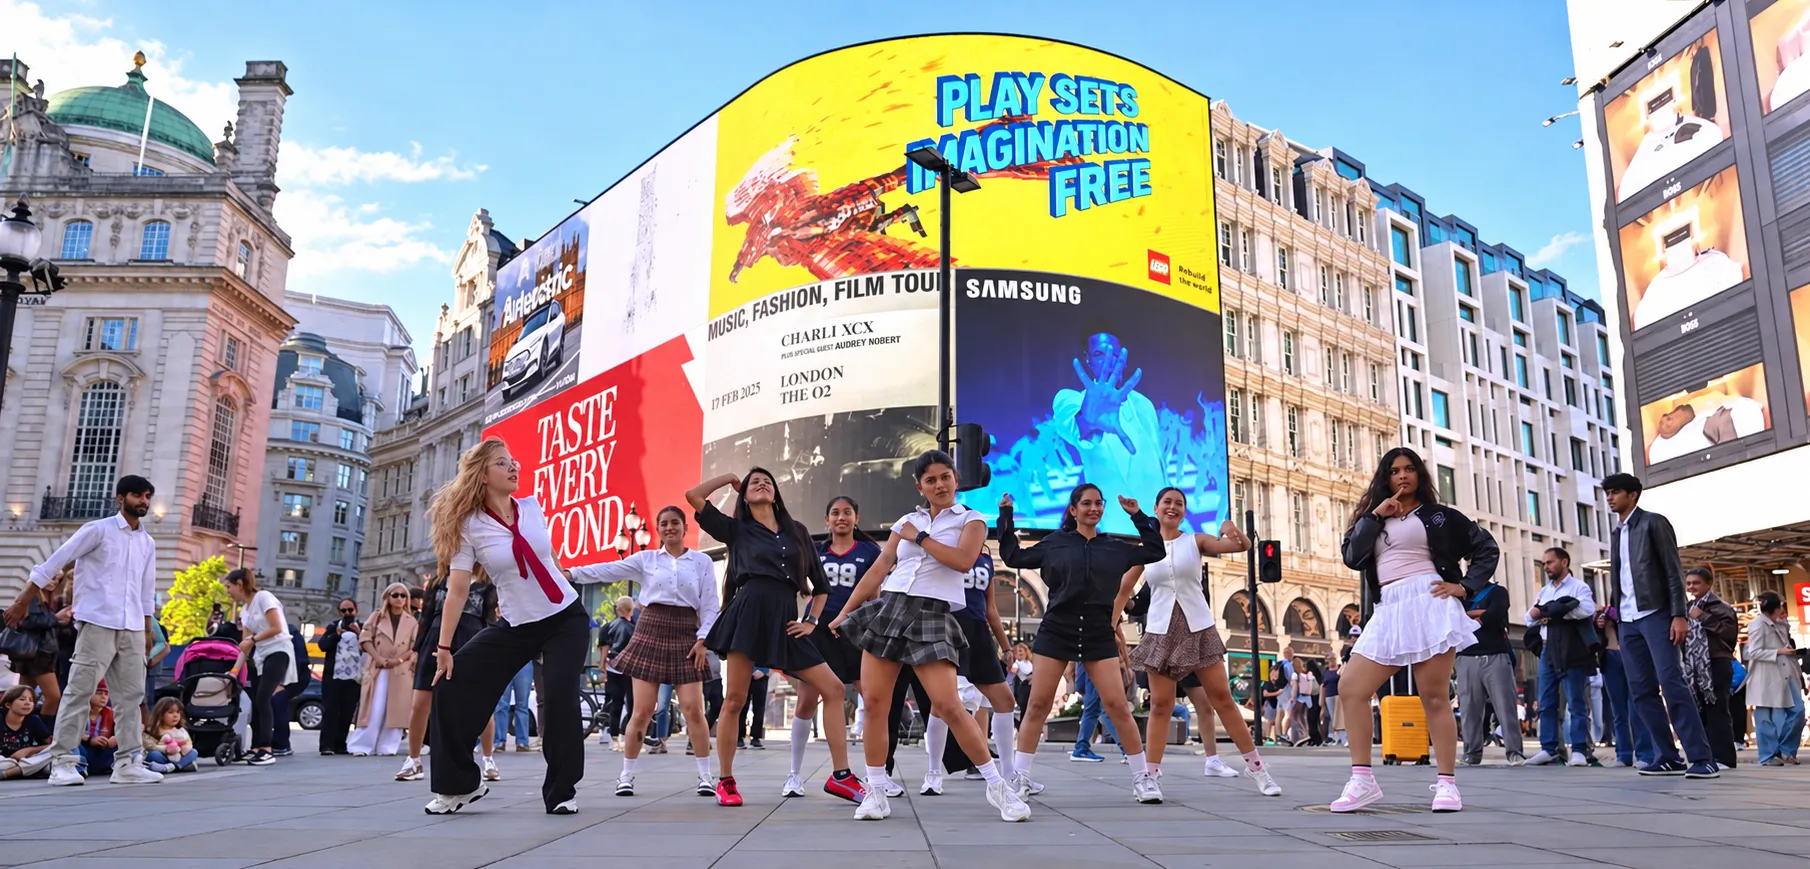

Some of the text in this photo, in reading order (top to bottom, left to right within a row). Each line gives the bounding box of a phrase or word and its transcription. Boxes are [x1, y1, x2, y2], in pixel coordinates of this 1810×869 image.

[936, 71, 1140, 127] PLAY SETS
[906, 119, 1150, 195] IMAGINATION
[1049, 158, 1152, 218] FREE
[1149, 258, 1169, 276] LEGO
[966, 278, 1081, 305] SAMSUNG
[1179, 277, 1191, 287] the
[707, 308, 749, 341] MUSIC,
[752, 285, 828, 321] FASHION,
[834, 276, 884, 301] FILM
[781, 320, 874, 347] CHARLI XCX
[835, 338, 867, 350] AUDREY
[780, 365, 844, 388] LONDON
[711, 381, 761, 410] 17 FEB 2025
[779, 388, 809, 404] THE
[537, 385, 618, 464] TASTE
[534, 440, 617, 513] EVERY
[546, 495, 625, 560] COND
